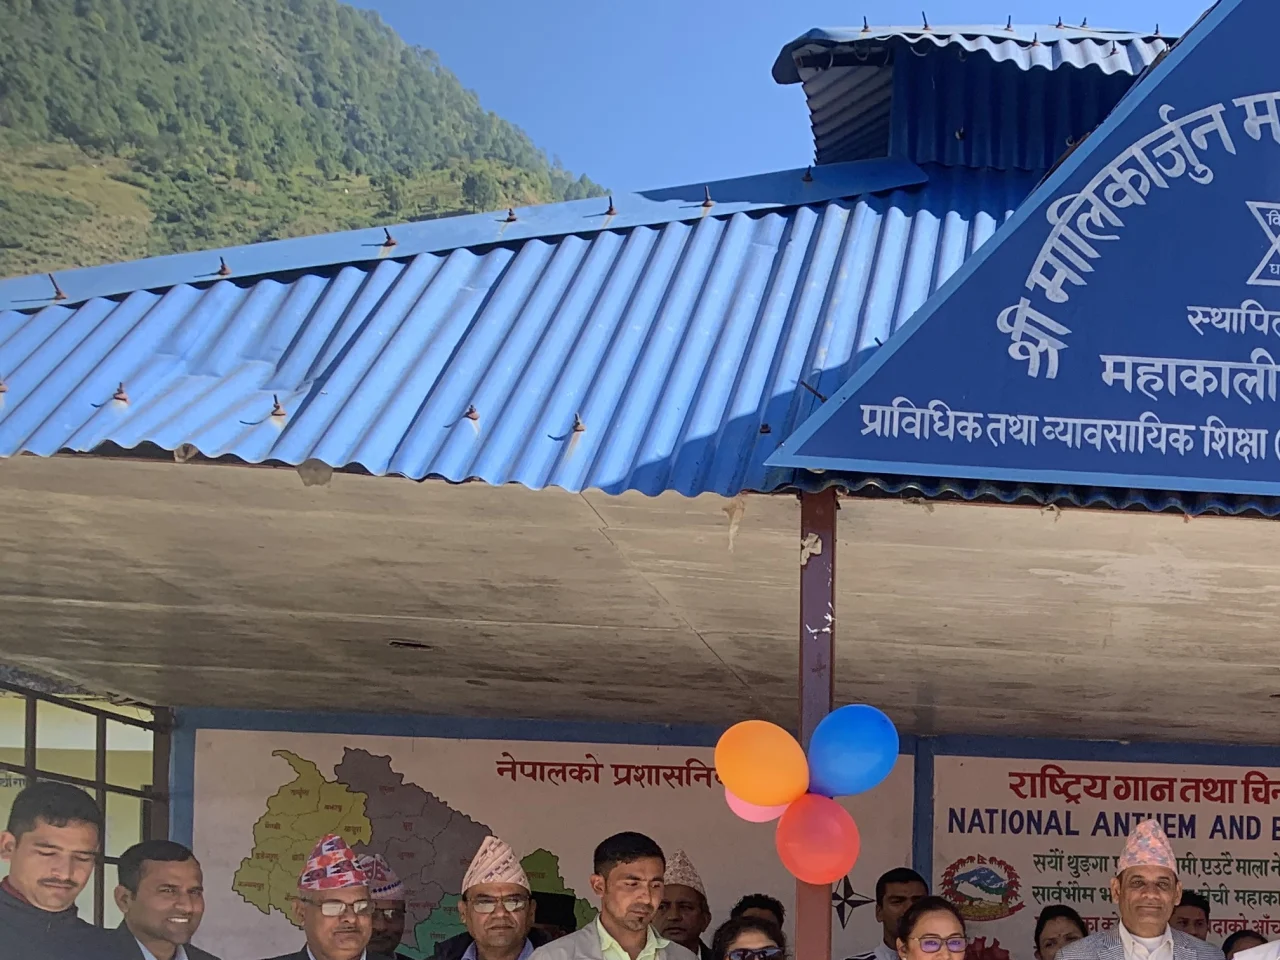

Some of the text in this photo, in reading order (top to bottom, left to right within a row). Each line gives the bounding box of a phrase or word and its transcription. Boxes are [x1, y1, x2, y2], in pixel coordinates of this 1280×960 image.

[1025, 104, 1236, 303] मालिकार्जुन
[997, 297, 1072, 379] श्री
[860, 396, 983, 441] प्राविधिक
[988, 413, 1039, 446] तथा
[1044, 411, 1195, 456] व्यावसायिक
[1200, 415, 1269, 463] शिक्षा
[496, 752, 725, 789] नेपालको प्रशासनि
[1008, 764, 1111, 804] राष्ट्रिय
[1113, 776, 1177, 803] गान
[1180, 778, 1237, 804] तथा
[948, 808, 1079, 836] NATIONAL
[1209, 815, 1261, 840] AND
[1236, 859, 1269, 879] माला
[1032, 881, 1096, 904] सार्वभौम
